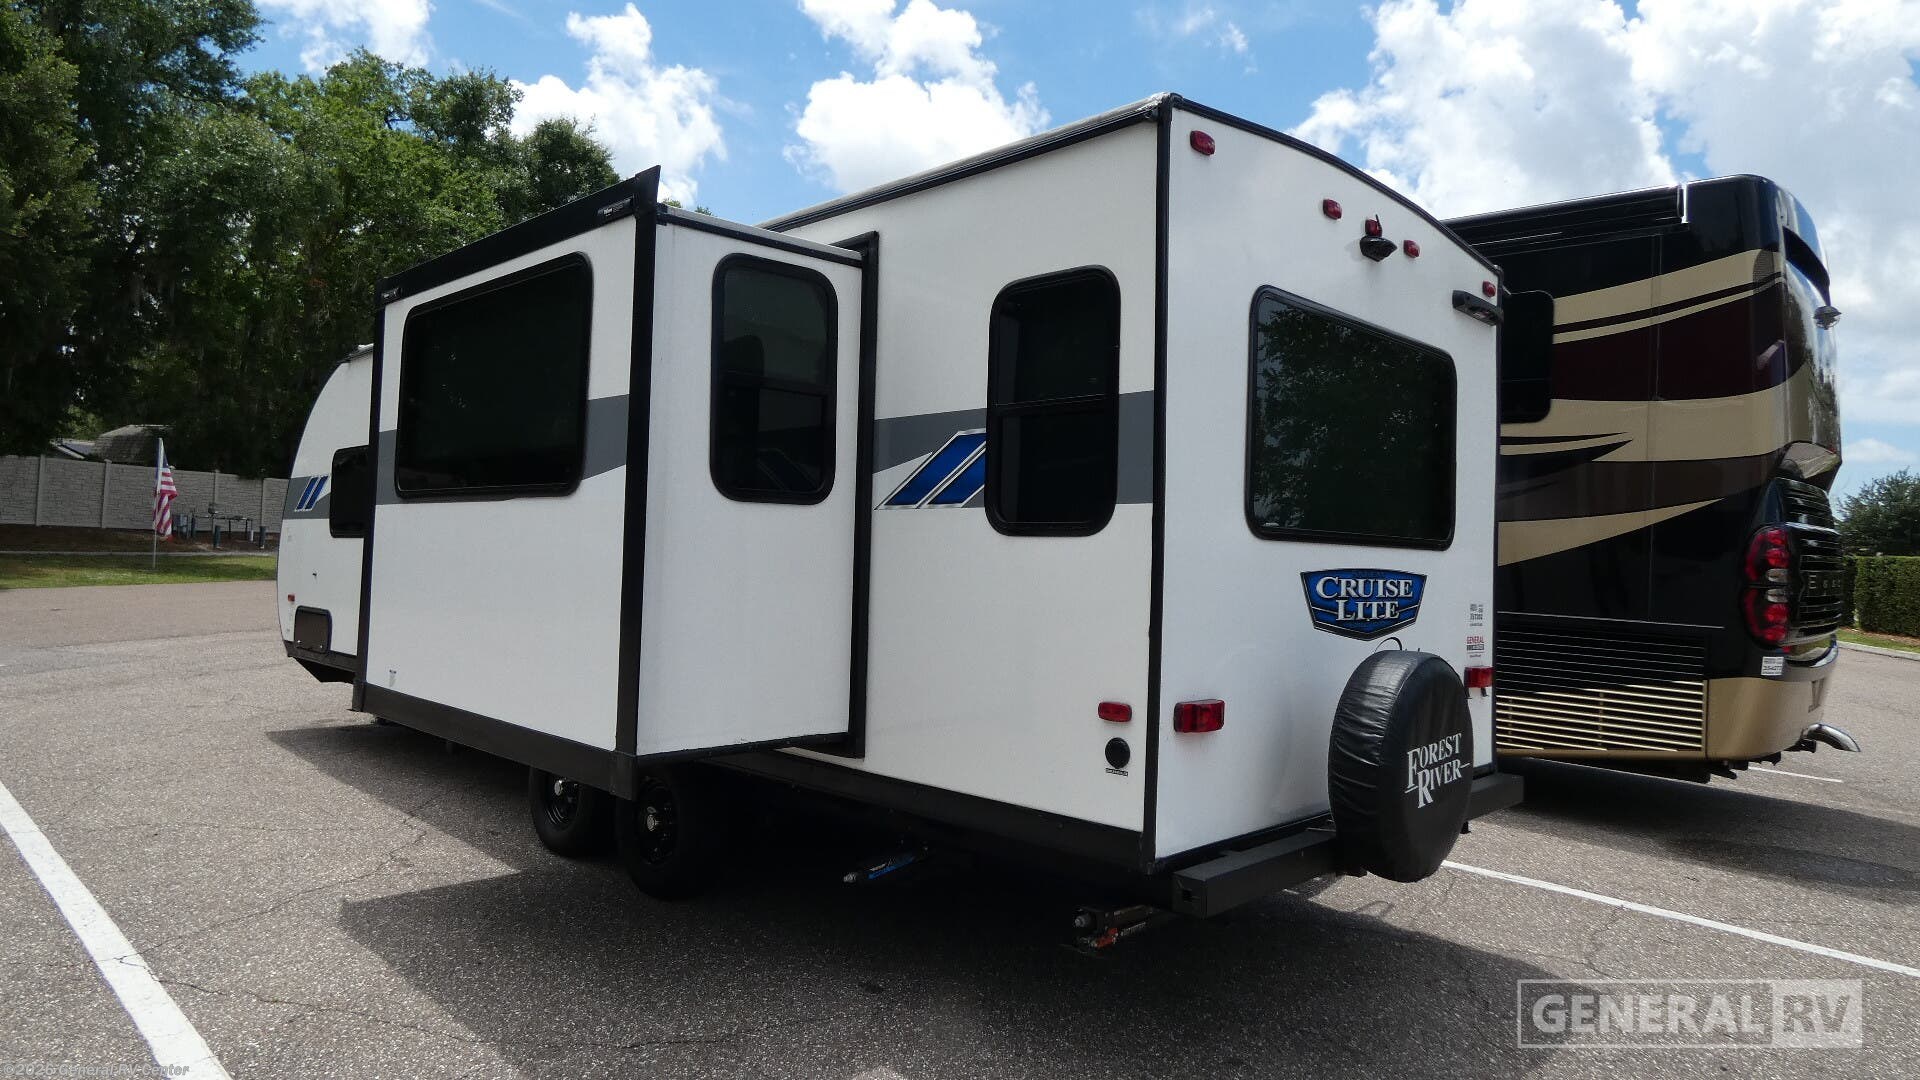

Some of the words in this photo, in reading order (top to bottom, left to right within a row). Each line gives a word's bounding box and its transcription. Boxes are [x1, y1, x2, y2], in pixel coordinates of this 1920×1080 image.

[1316, 576, 1413, 599] CRUISE
[1336, 599, 1400, 621] LITE
[1407, 733, 1462, 789] FOREST
[1417, 759, 1462, 809] RIVER
